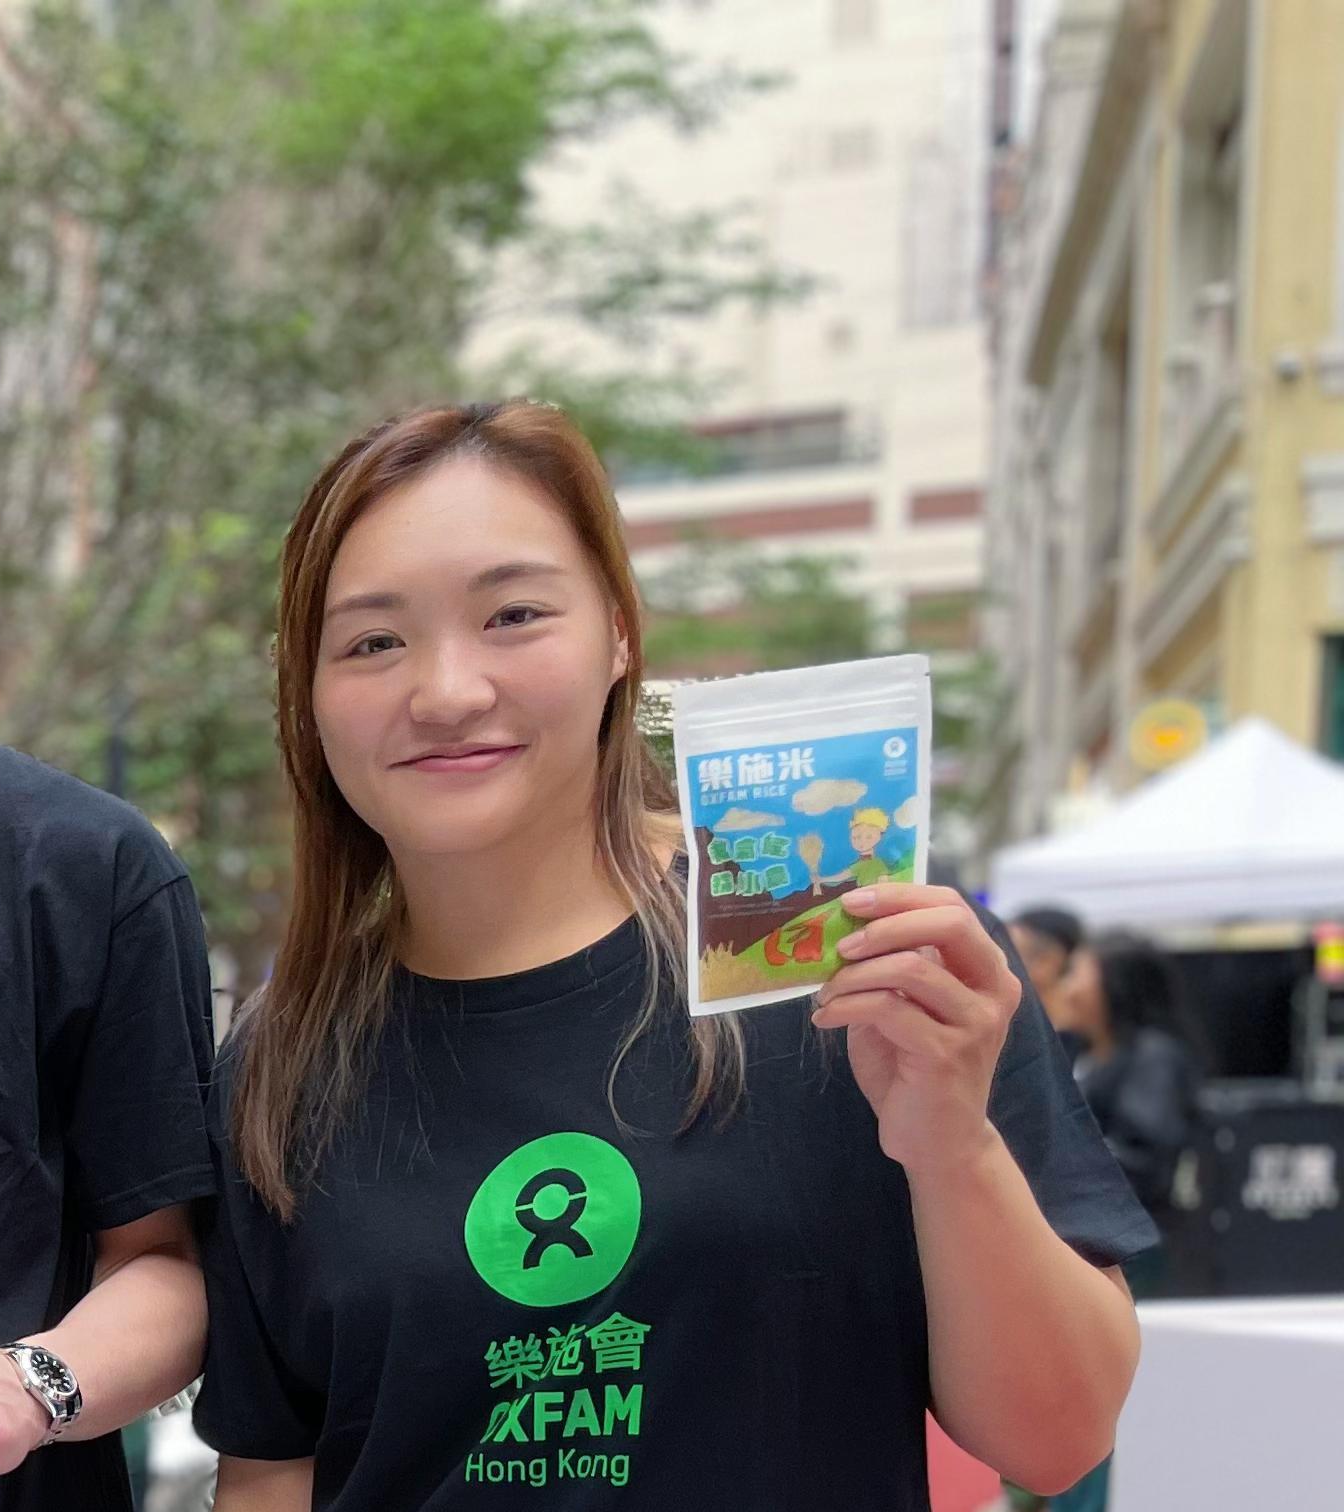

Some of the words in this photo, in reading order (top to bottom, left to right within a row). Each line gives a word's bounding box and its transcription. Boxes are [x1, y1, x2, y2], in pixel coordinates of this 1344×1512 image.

[699, 747, 815, 792] 樂施米
[484, 1311, 652, 1390] 樂施會
[465, 1452, 547, 1488] Hong
[558, 1448, 630, 1487] Kong
